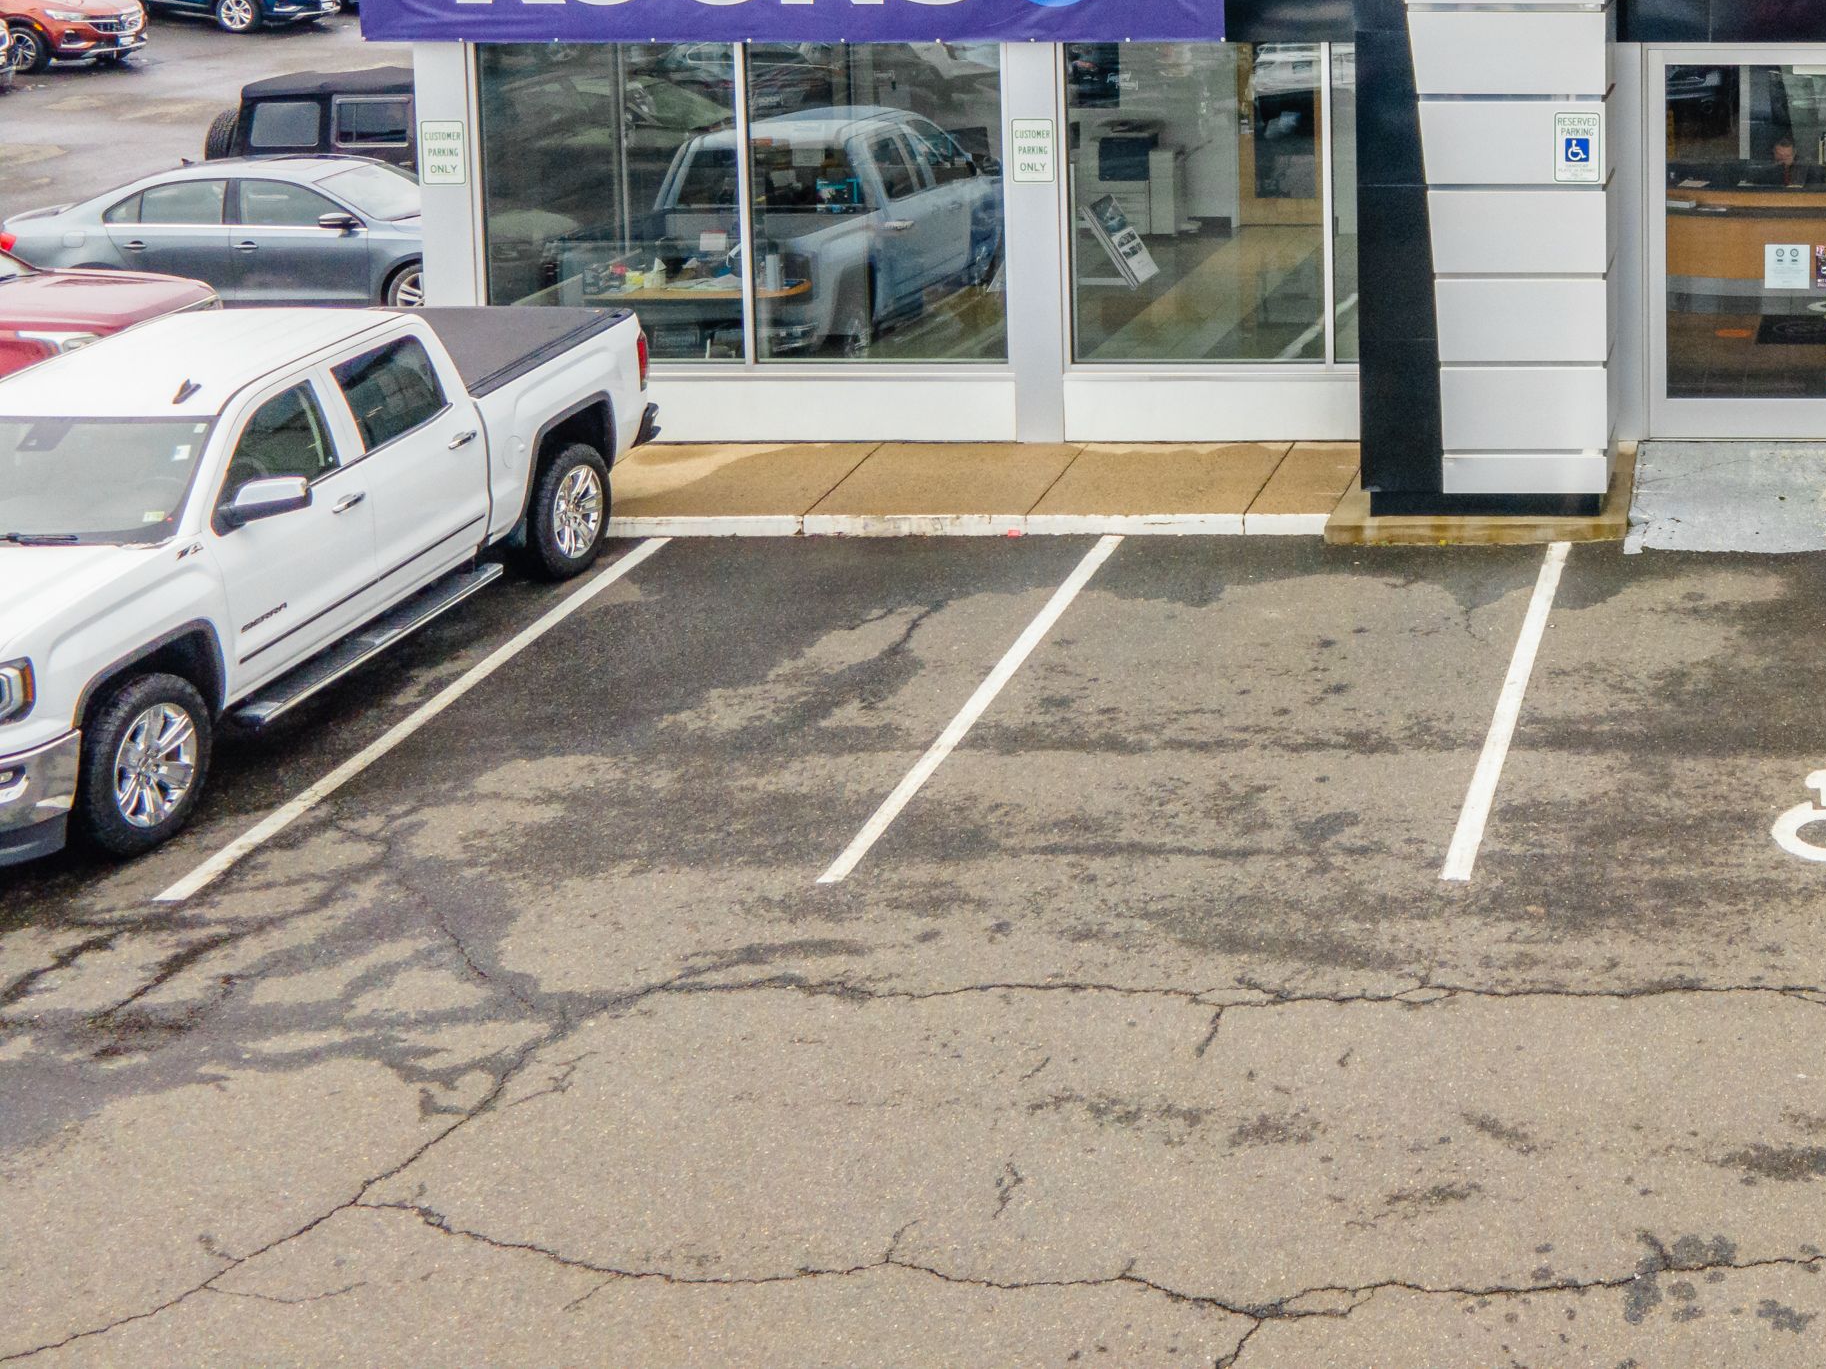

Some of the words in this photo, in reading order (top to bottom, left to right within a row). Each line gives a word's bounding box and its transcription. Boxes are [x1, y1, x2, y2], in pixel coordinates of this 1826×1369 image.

[1557, 117, 1598, 127] RESERVED
[424, 132, 461, 141] CUSTOMER
[1014, 130, 1051, 139] CUSTOMER
[1561, 128, 1594, 137] PARKING
[427, 148, 459, 157] PARKING
[1018, 146, 1048, 155] PARKING
[430, 164, 458, 174] ONLY
[1020, 162, 1047, 172] ONLY
